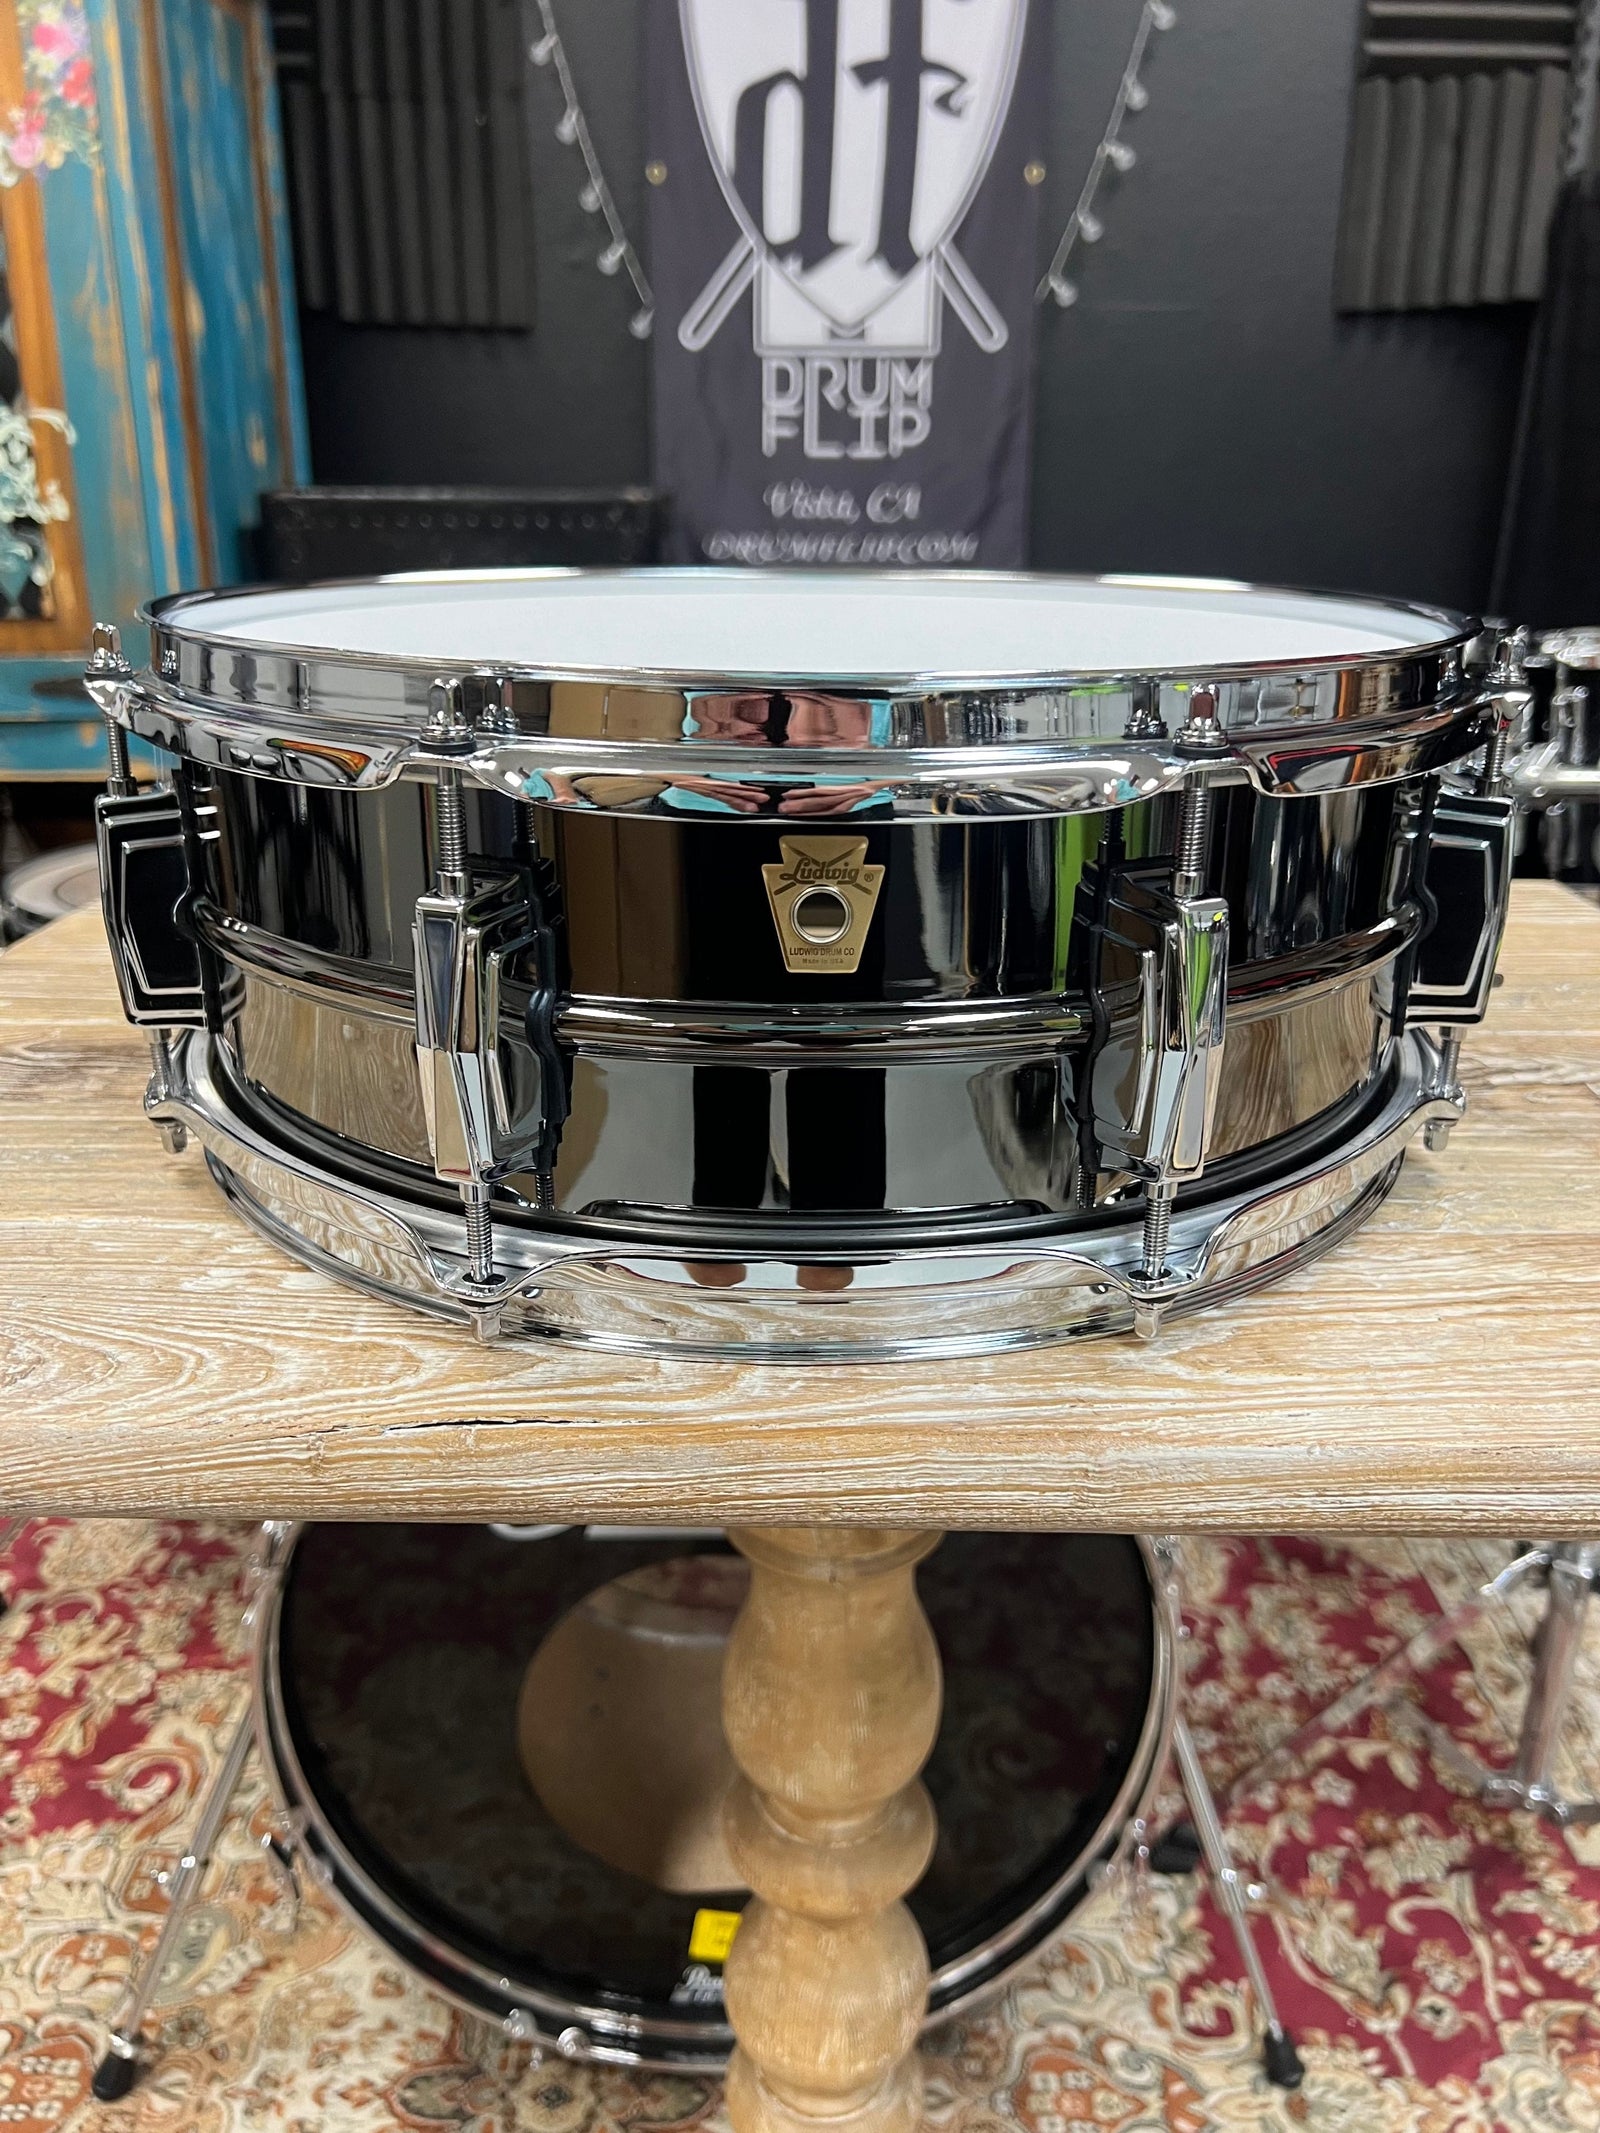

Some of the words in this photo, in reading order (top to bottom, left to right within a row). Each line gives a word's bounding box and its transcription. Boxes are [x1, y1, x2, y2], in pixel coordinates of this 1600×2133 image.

[761, 357, 934, 410] DRUM
[761, 403, 932, 459] FLIP
[779, 857, 860, 885] Ludwig
[789, 947, 820, 956] LUDWIG
[820, 947, 843, 956] DRUM
